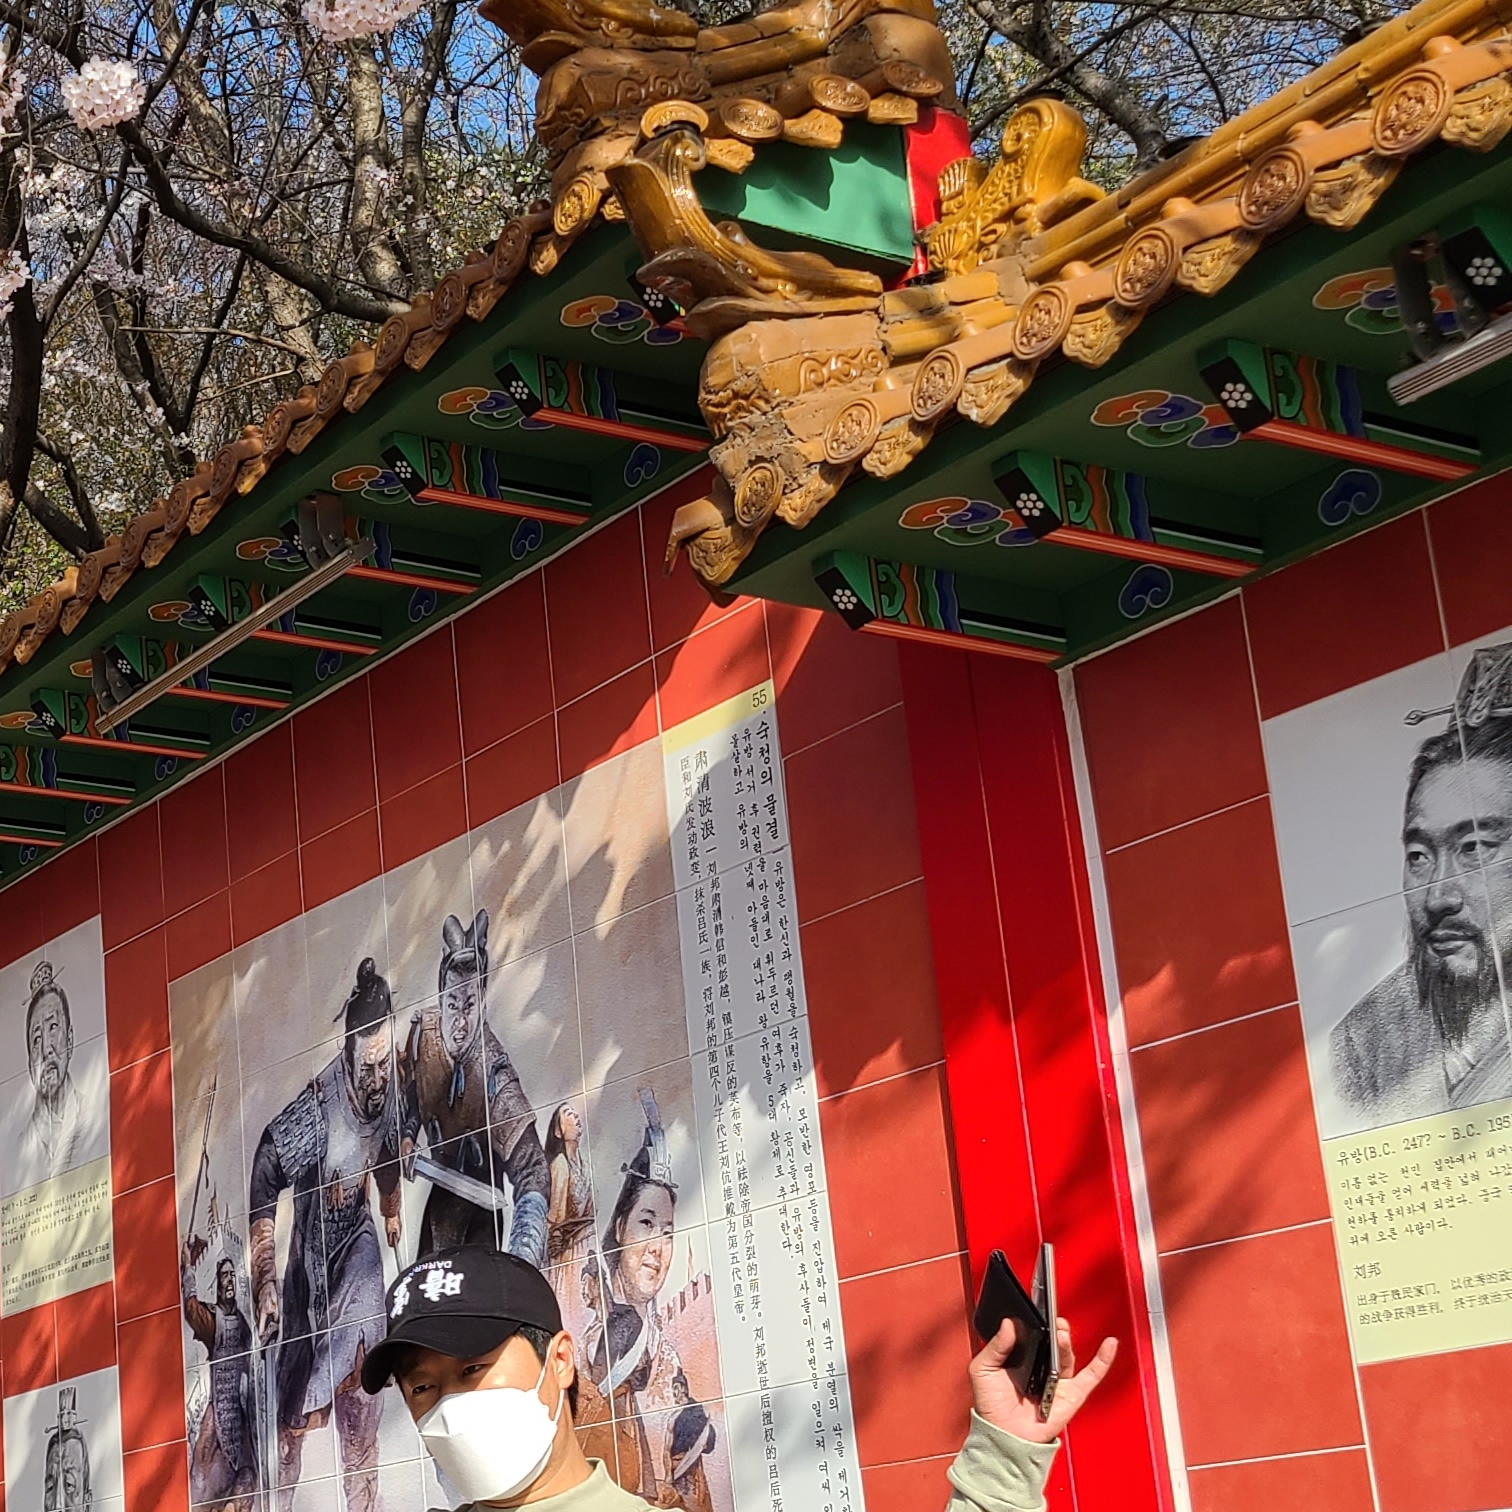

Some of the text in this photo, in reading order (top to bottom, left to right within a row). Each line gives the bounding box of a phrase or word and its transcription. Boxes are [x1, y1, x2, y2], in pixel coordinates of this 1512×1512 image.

[737, 727, 755, 763] 유방
[754, 720, 774, 788] 숙청의
[741, 763, 758, 795] 서거
[736, 803, 751, 850] 유방의
[745, 800, 761, 822] 후
[761, 792, 779, 840] 물결
[755, 876, 774, 944] 마음대로
[768, 860, 786, 912] 유방은
[746, 900, 762, 948] 아들인
[774, 914, 795, 966] 한신과
[752, 956, 767, 1004] 대나라
[762, 950, 782, 1018] 휘두르던
[756, 1010, 771, 1033] 왕
[769, 1022, 789, 1076] 여후가
[795, 1107, 817, 1159] 모반한
[1450, 1122, 1481, 1140] B.C.
[1486, 1113, 1511, 1132] 195
[769, 1129, 786, 1178] 황제로
[780, 1128, 800, 1195] 공신들과
[1340, 1176, 1362, 1190] 이름
[1484, 1143, 1512, 1159] 태어
[774, 1183, 793, 1258] 추대한다.
[791, 1206, 804, 1256] 유방의
[1375, 1226, 1398, 1242] 오른
[1403, 1216, 1452, 1235] 사람이다.
[811, 1239, 827, 1308] 진압하여
[1352, 1261, 1381, 1279] 刘邦
[821, 1317, 834, 1352] 제국
[811, 1397, 830, 1453] 일으켜
[829, 1418, 848, 1460] 싹을
